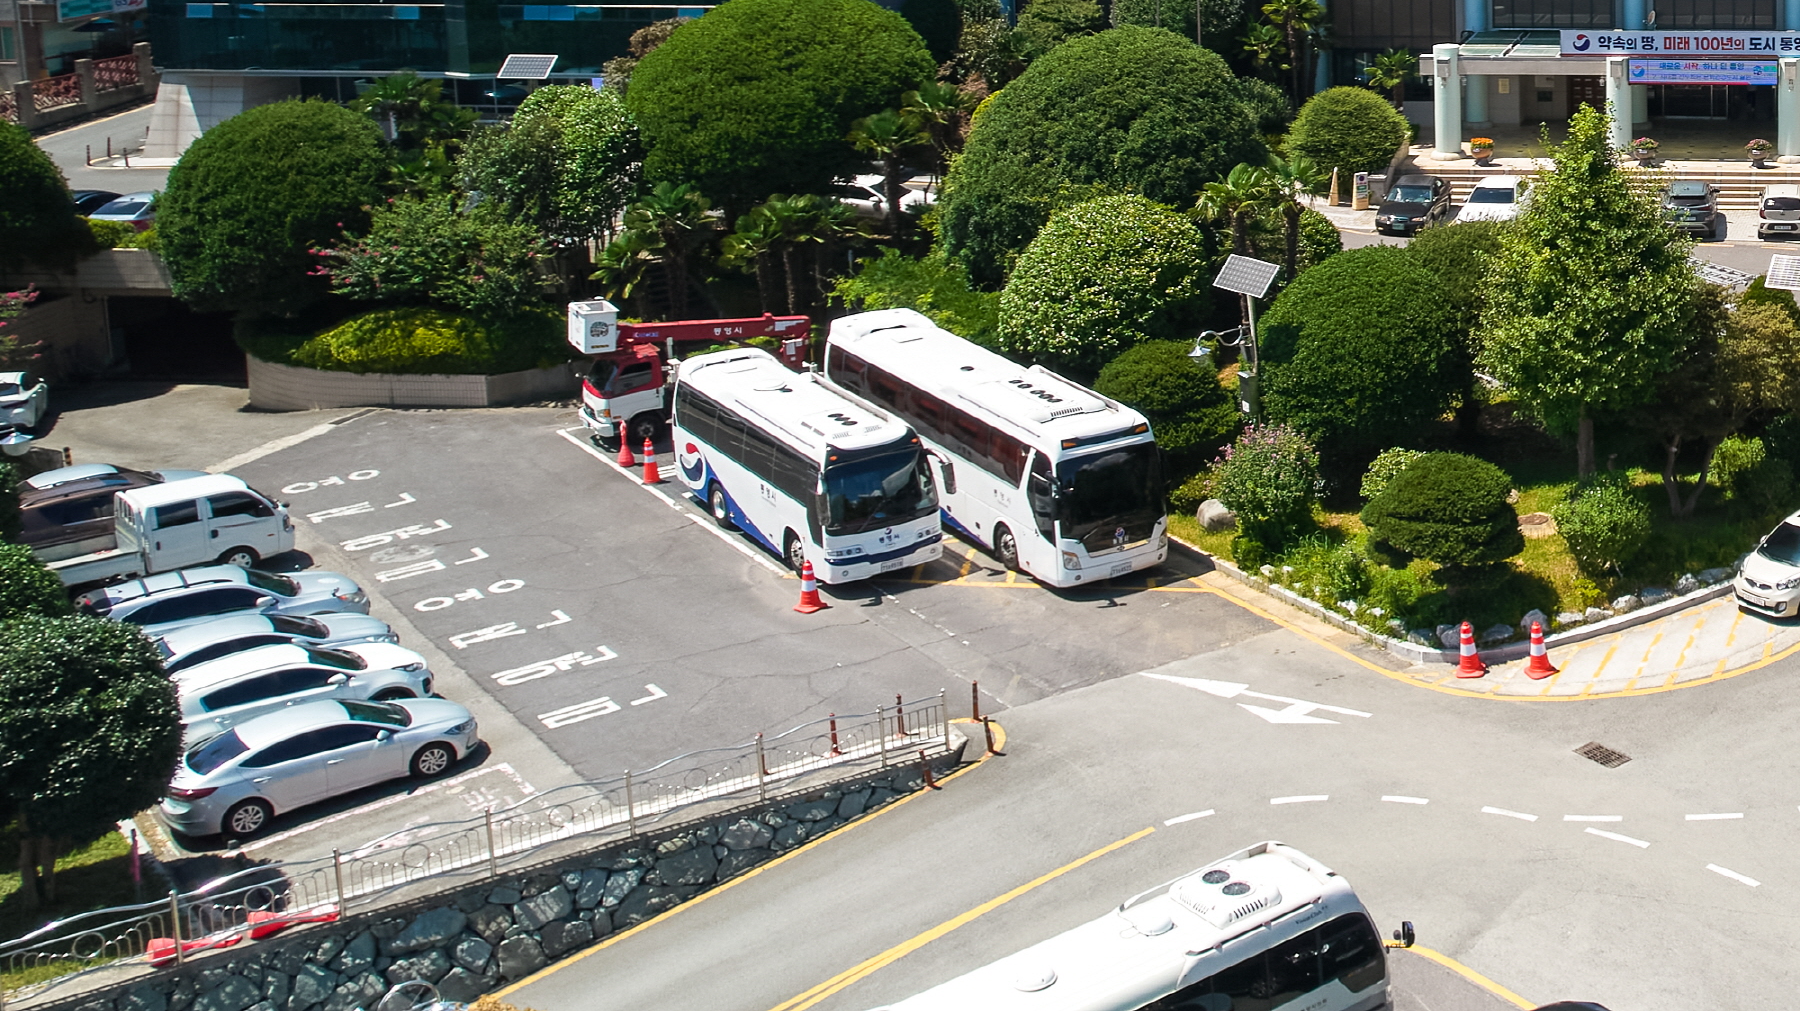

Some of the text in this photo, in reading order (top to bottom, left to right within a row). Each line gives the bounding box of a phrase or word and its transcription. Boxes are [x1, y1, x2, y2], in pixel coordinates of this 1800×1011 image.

[1598, 36, 1637, 51] 약속의
[1641, 36, 1659, 52] 땅,
[1663, 36, 1690, 51] 미래
[1694, 36, 1745, 51] 100년의
[1749, 37, 1776, 51] 도시
